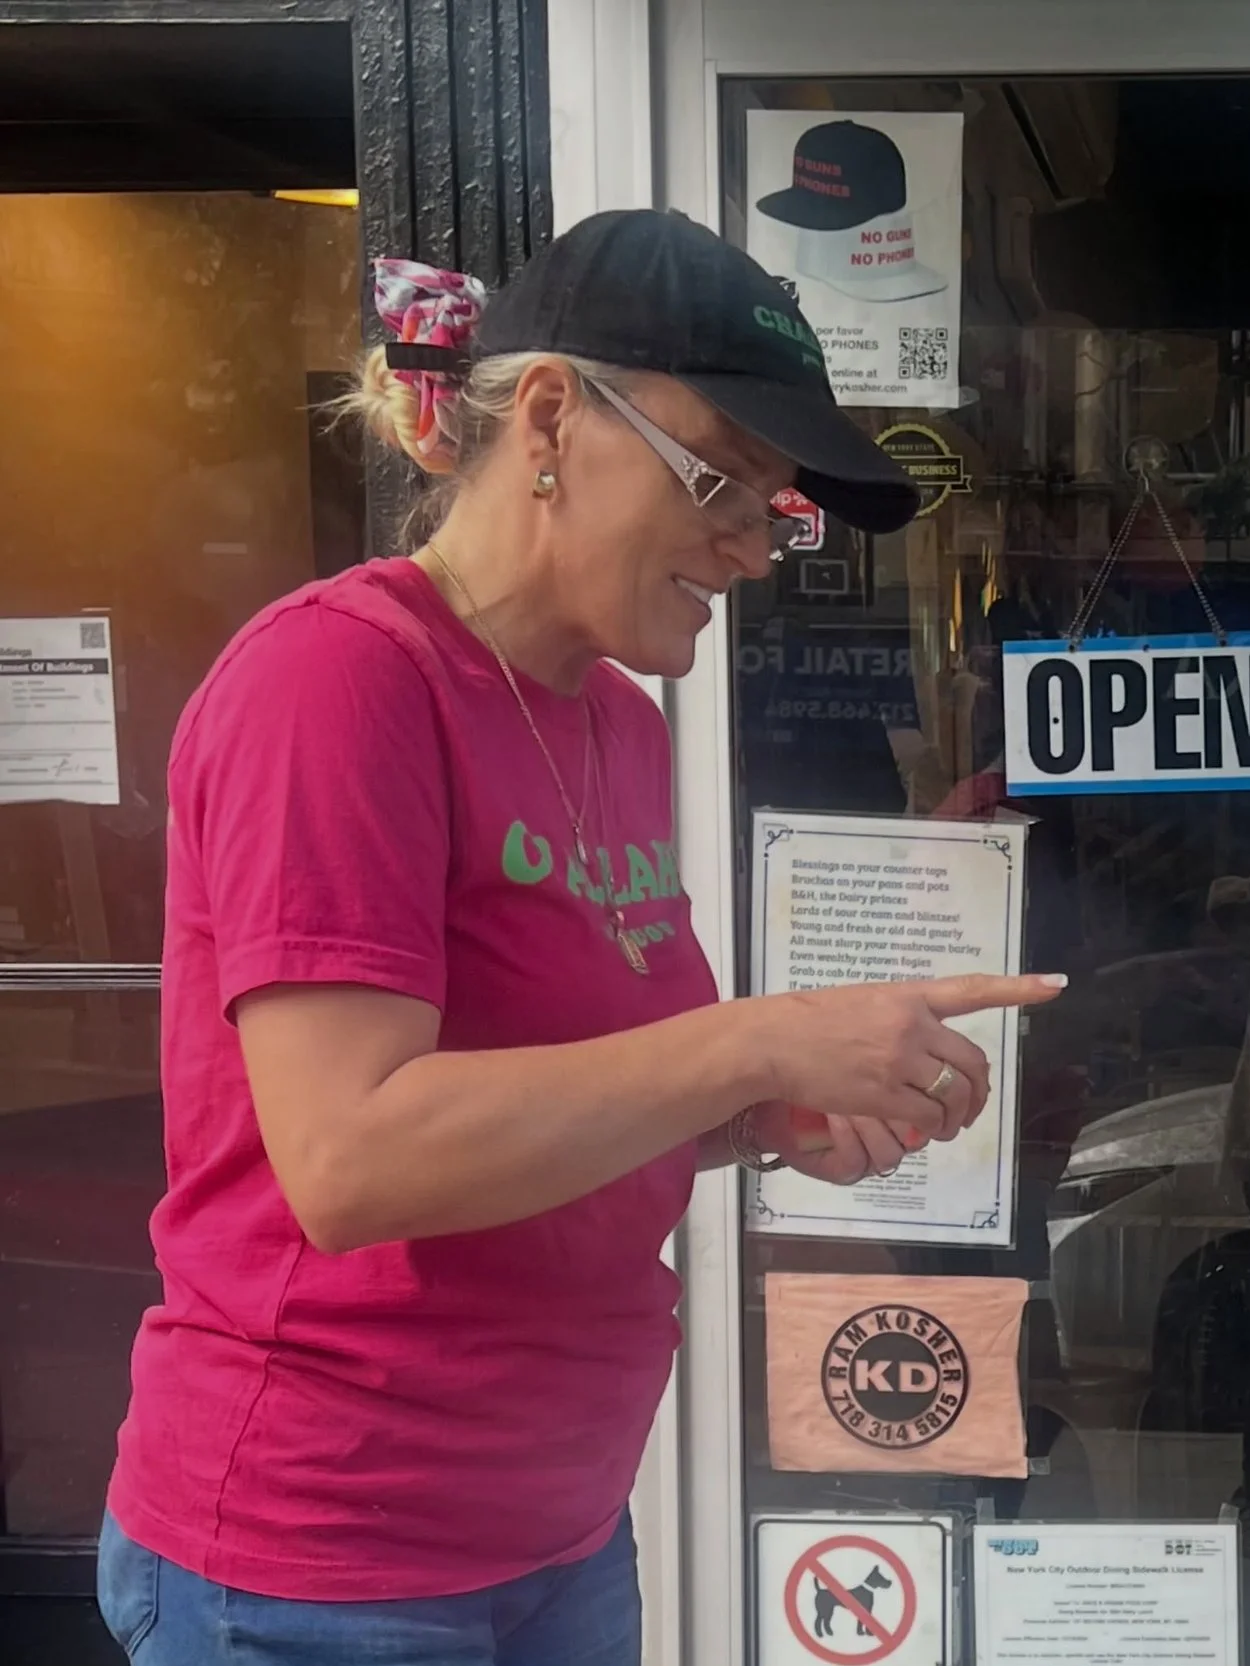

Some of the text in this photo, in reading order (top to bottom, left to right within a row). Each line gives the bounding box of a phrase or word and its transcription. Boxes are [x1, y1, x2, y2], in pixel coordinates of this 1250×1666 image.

[861, 231, 883, 244] NO
[851, 253, 873, 266] NO
[831, 340, 880, 351] PHONES
[831, 368, 878, 378] online at
[908, 464, 957, 476] BUSINESS
[46, 662, 95, 674] Buildings
[857, 864, 881, 874] your
[852, 879, 876, 889] your
[791, 904, 820, 917] Lords
[790, 920, 822, 933] Young
[864, 940, 888, 951] your
[890, 940, 947, 953] mushroom
[789, 950, 815, 961] Even
[788, 964, 816, 977] Grab
[864, 970, 888, 982] your
[828, 1310, 963, 1383] RAM KOSHER
[854, 1359, 940, 1394] KD
[831, 1390, 959, 1442] 718 314 5815
[1007, 1566, 1025, 1574] New
[1027, 1565, 1046, 1574] York
